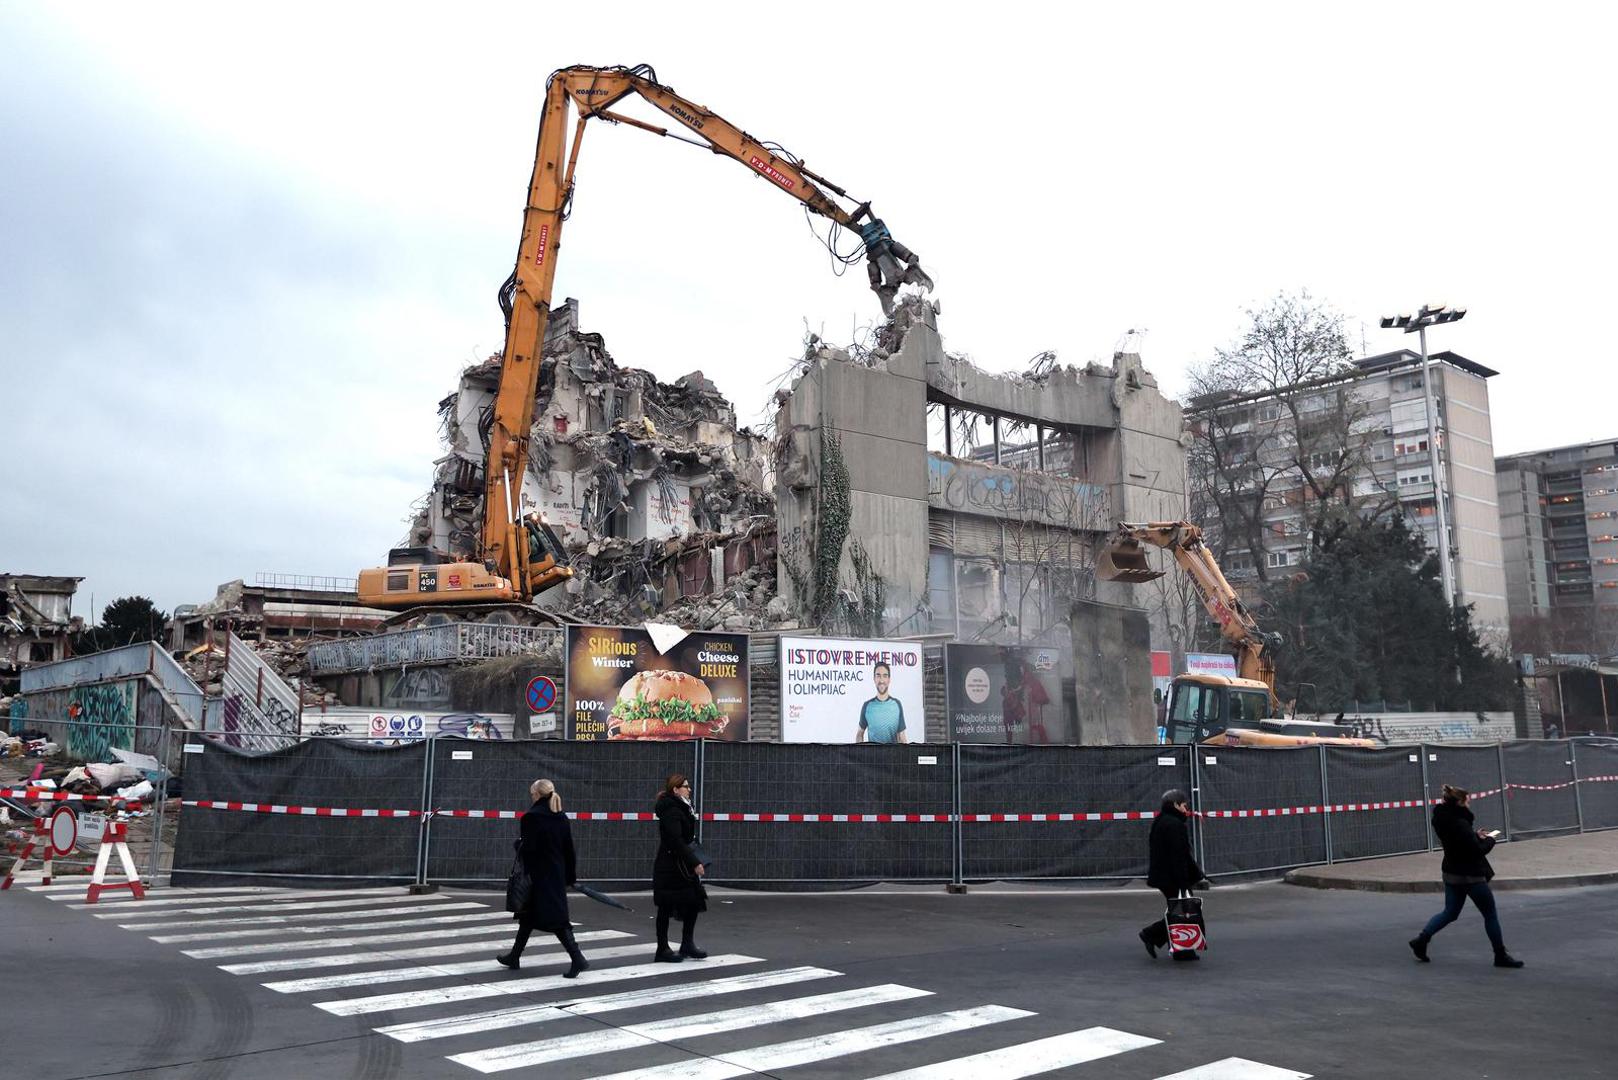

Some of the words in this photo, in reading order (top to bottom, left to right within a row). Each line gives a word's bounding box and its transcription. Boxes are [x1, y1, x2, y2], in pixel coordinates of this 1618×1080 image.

[669, 103, 705, 129] KOMATSU
[420, 578, 436, 586] 450
[588, 637, 637, 656] SIRious
[704, 641, 733, 652] CHICKEN
[592, 656, 634, 668] Winter
[697, 651, 739, 663] Cheese
[788, 648, 918, 667] ISTOVREMENO
[700, 664, 737, 678] DELUXE
[788, 669, 864, 682] HUMANITARAC
[788, 684, 792, 695] I
[793, 683, 846, 696] OLIMPIJAC
[575, 700, 605, 711] 100%
[576, 711, 592, 722] FILE
[576, 720, 605, 733] PILEĆIH
